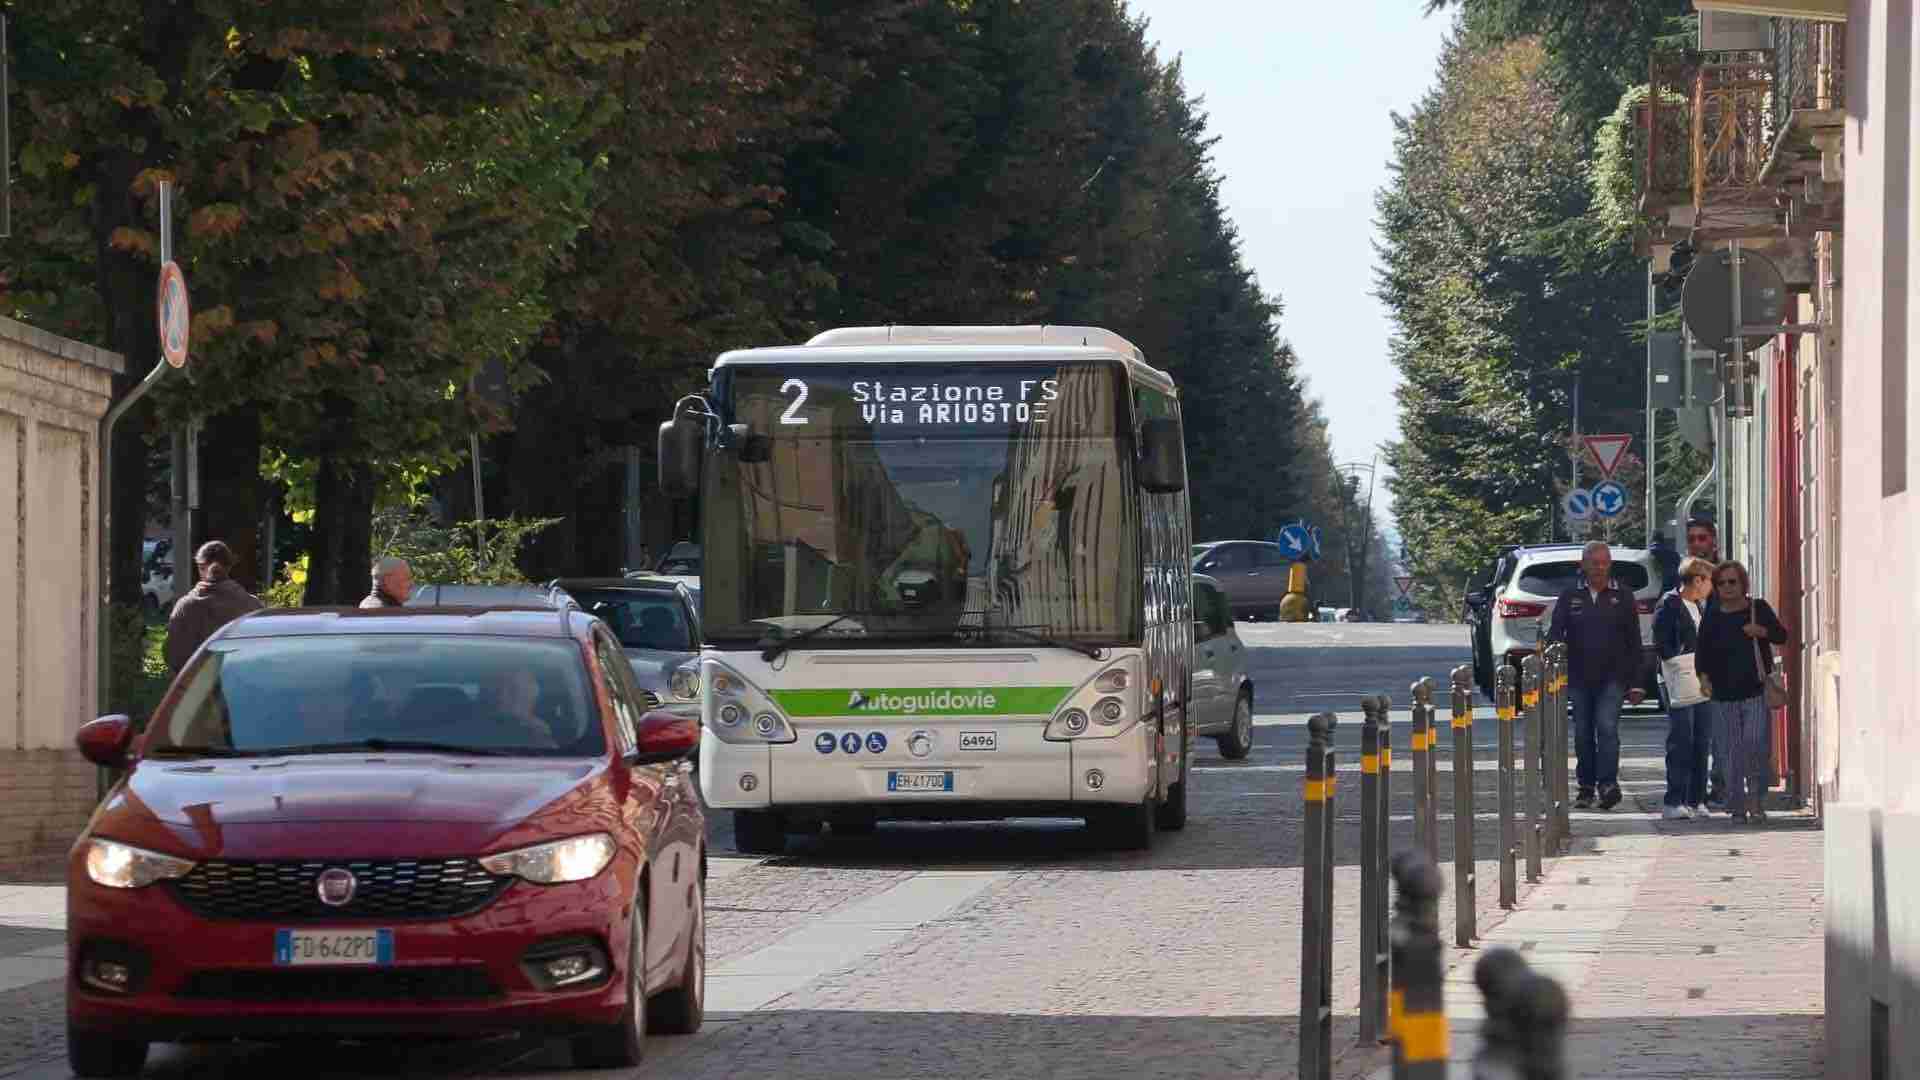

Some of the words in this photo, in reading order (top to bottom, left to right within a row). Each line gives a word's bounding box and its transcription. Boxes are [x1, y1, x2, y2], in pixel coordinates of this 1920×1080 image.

[780, 378, 808, 424] 2
[852, 381, 1003, 401] Stazione
[1020, 380, 1058, 400] FS
[862, 403, 904, 423] Via
[848, 688, 996, 713] Autoguidovie
[962, 735, 994, 746] 6496
